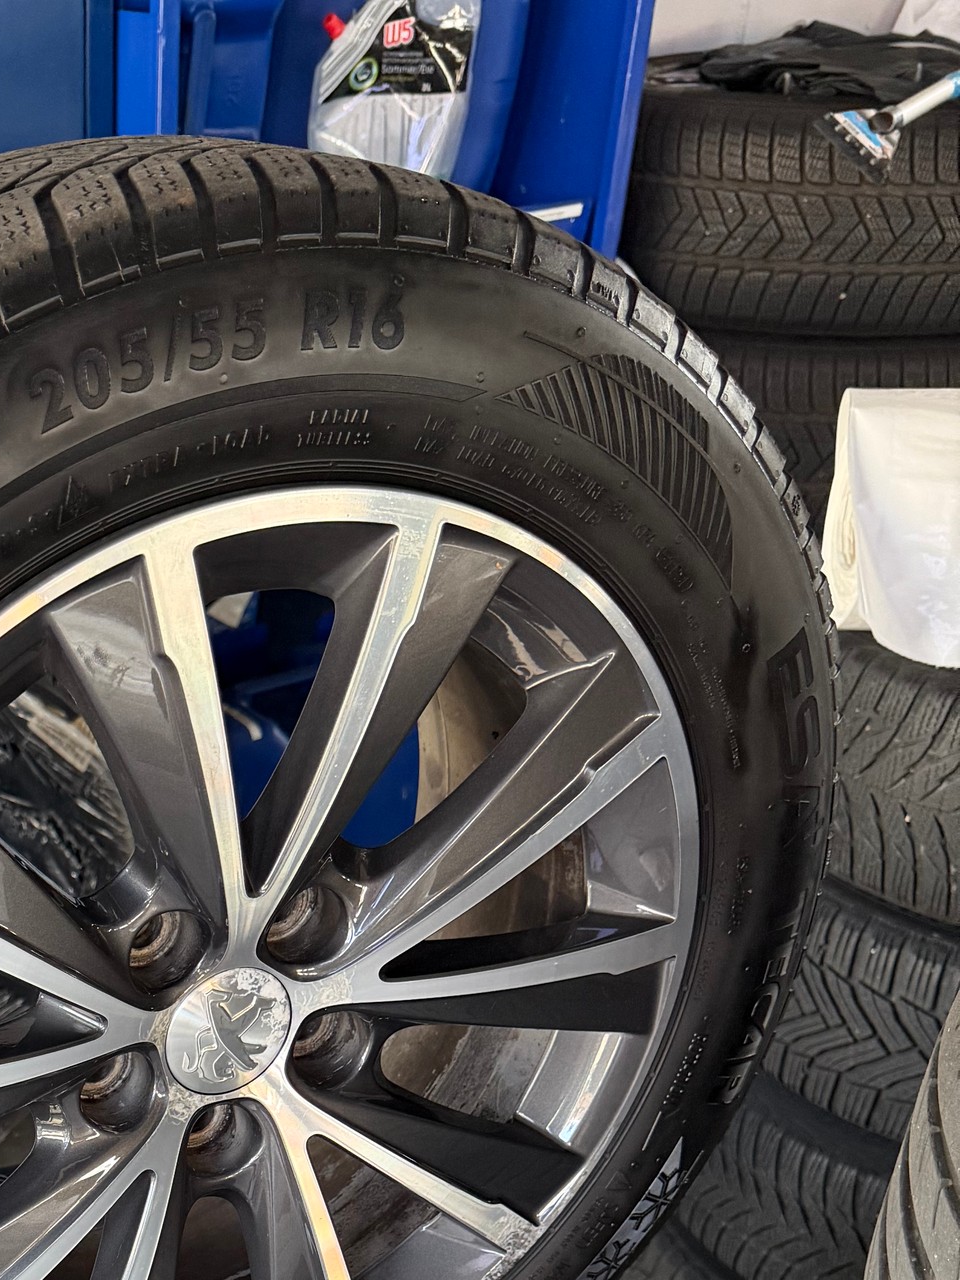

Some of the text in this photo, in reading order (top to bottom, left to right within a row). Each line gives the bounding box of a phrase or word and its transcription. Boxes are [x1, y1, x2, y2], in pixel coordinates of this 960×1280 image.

[383, 16, 416, 49] W5
[31, 288, 406, 434] 205/55 R16
